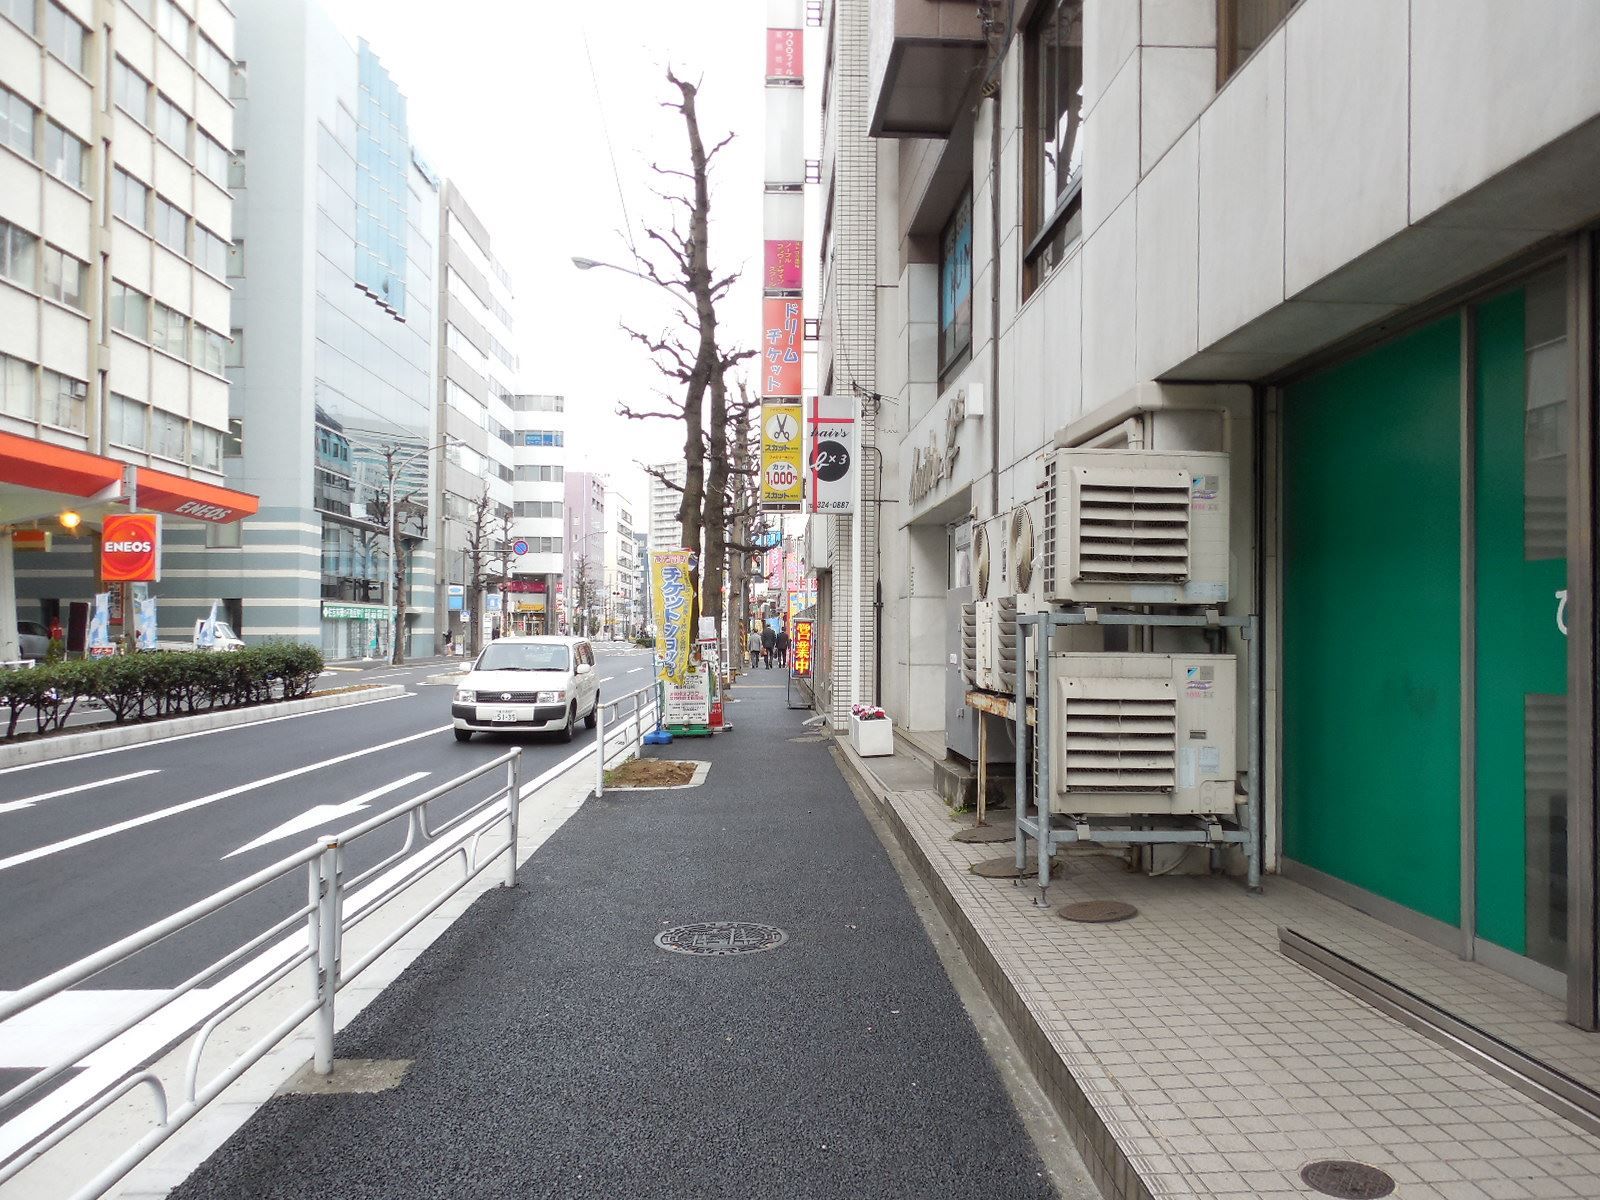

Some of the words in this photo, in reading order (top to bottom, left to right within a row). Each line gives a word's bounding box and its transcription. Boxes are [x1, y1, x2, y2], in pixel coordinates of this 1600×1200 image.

[784, 303, 798, 363] ドリーム
[766, 329, 782, 392] チケット
[765, 444, 789, 452] スカット
[175, 500, 233, 520] ENEOS
[104, 541, 151, 553] ENEOS
[661, 566, 685, 677] チケットショップ
[796, 623, 810, 674] 営業中
